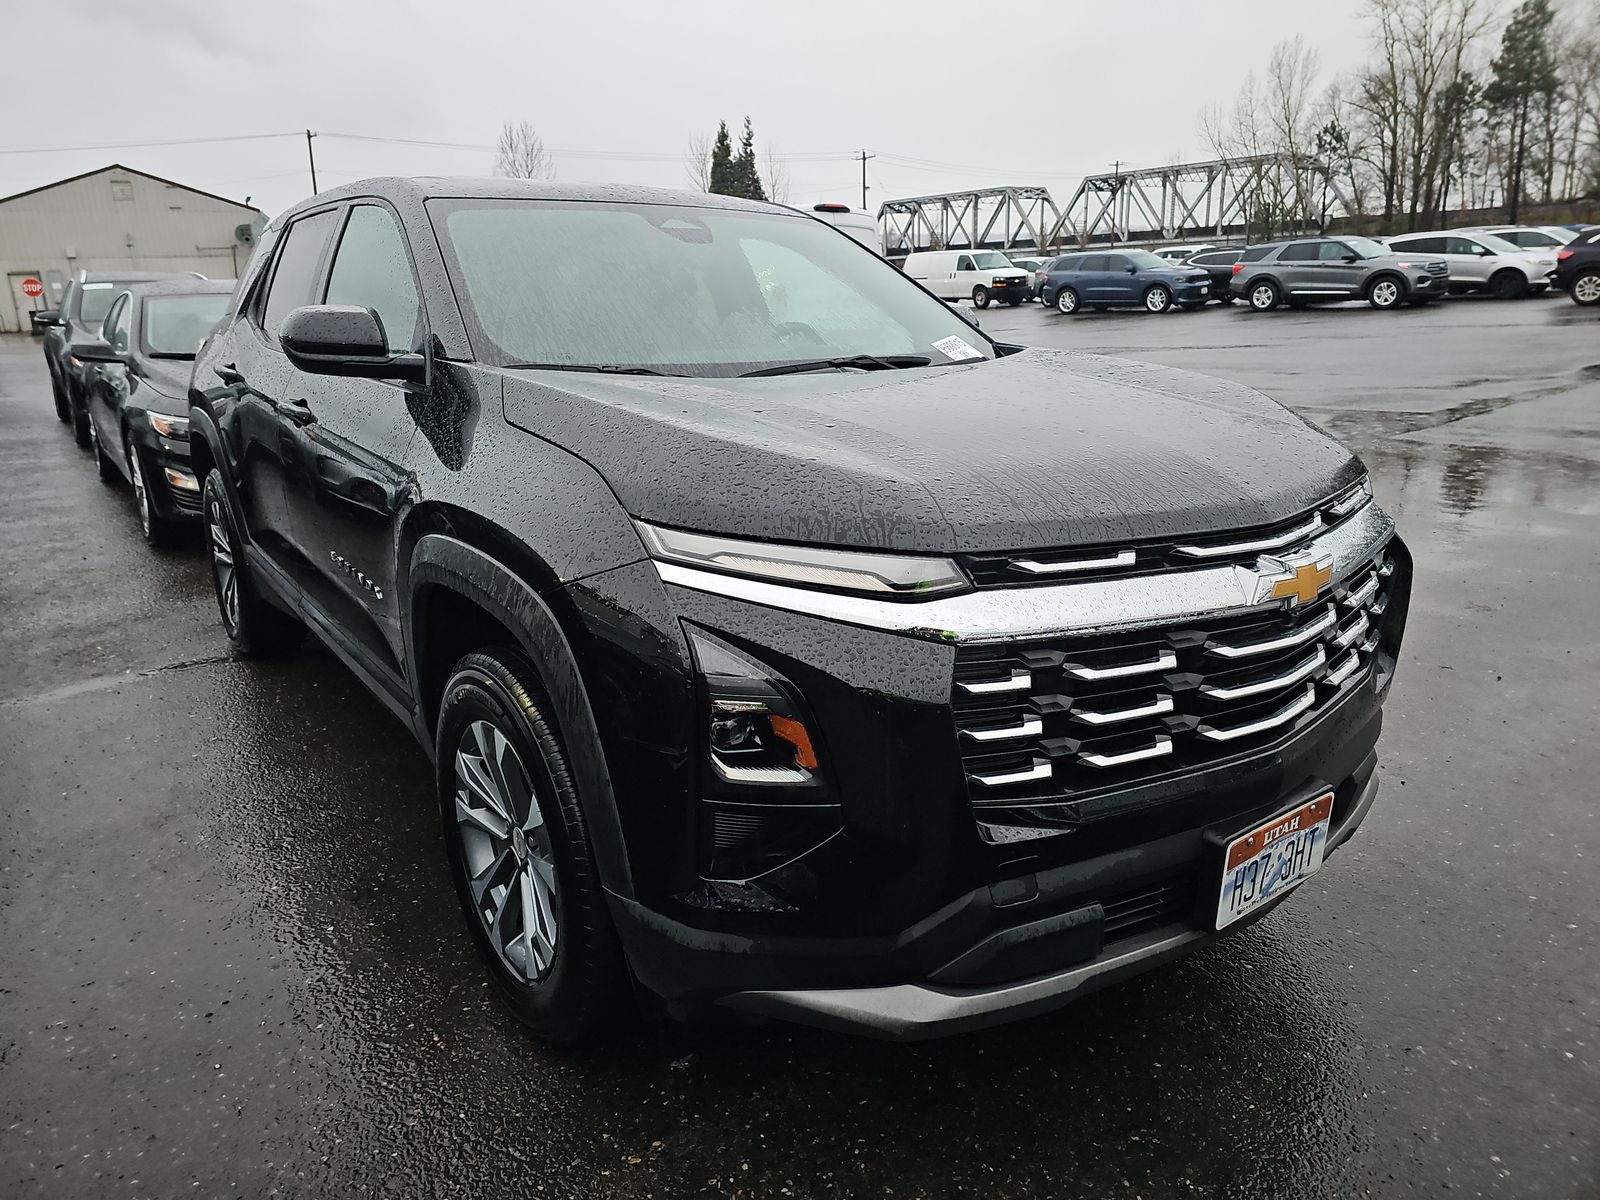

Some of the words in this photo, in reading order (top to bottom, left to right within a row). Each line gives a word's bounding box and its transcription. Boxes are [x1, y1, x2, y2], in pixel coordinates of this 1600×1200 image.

[23, 284, 42, 293] STOP
[1263, 815, 1301, 847] UTAH
[1230, 853, 1271, 911] H37
[1281, 826, 1320, 881] 3HT
